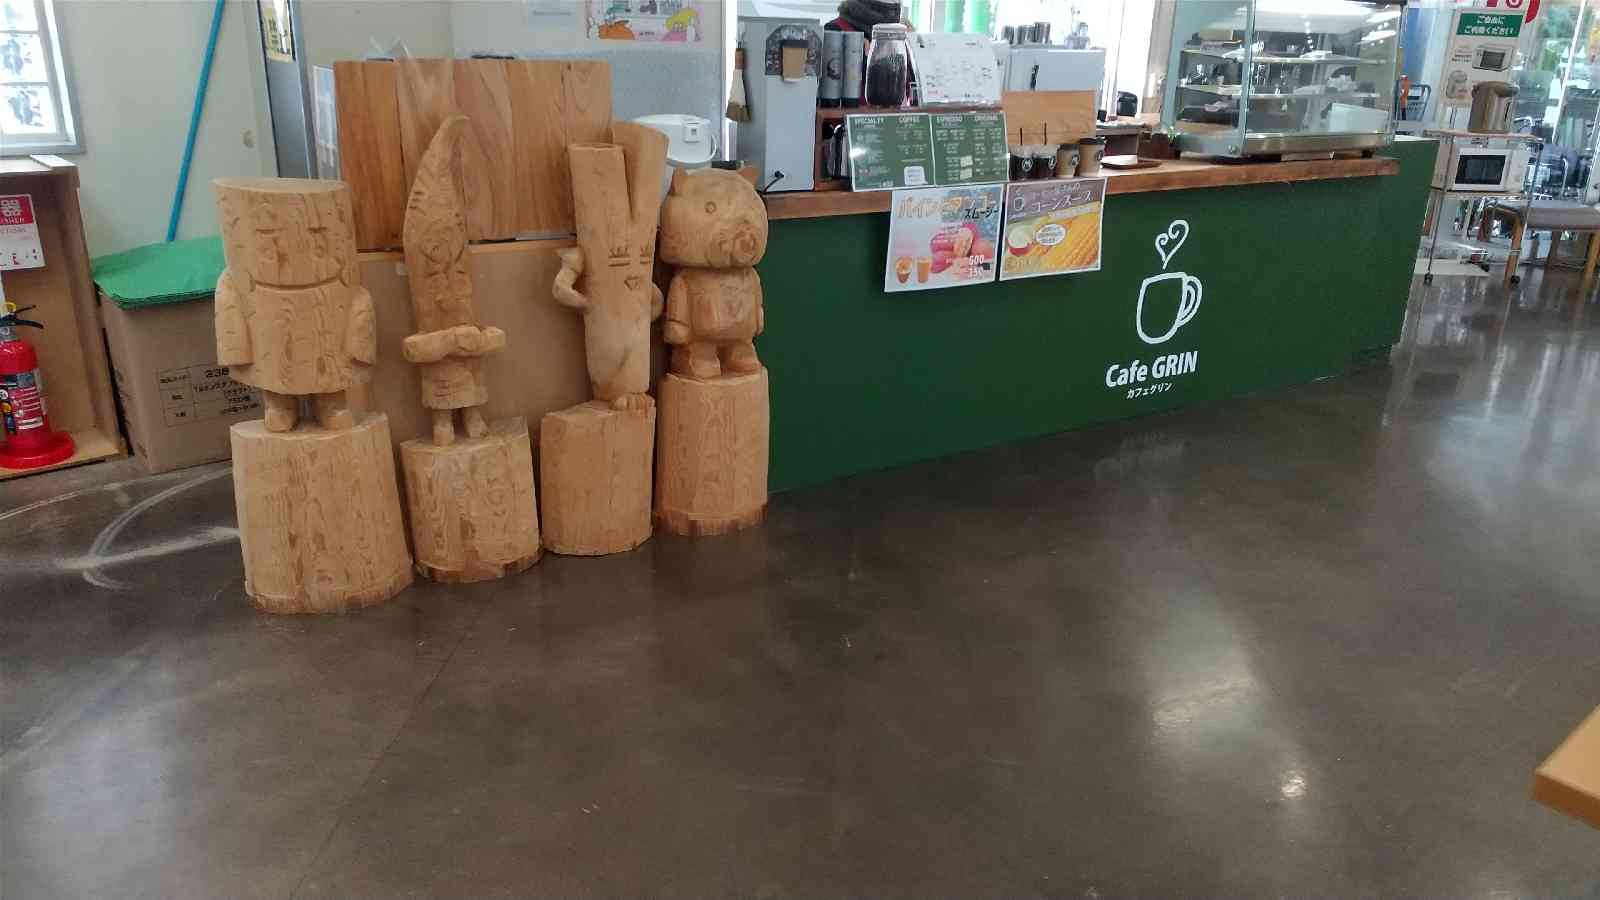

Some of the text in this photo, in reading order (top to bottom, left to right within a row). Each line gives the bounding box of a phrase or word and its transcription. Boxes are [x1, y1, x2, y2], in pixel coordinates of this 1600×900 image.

[1464, 25, 1513, 35] ご利用ください
[1105, 351, 1197, 388] Cafe GRIN
[1126, 382, 1172, 399] カフェグリン
